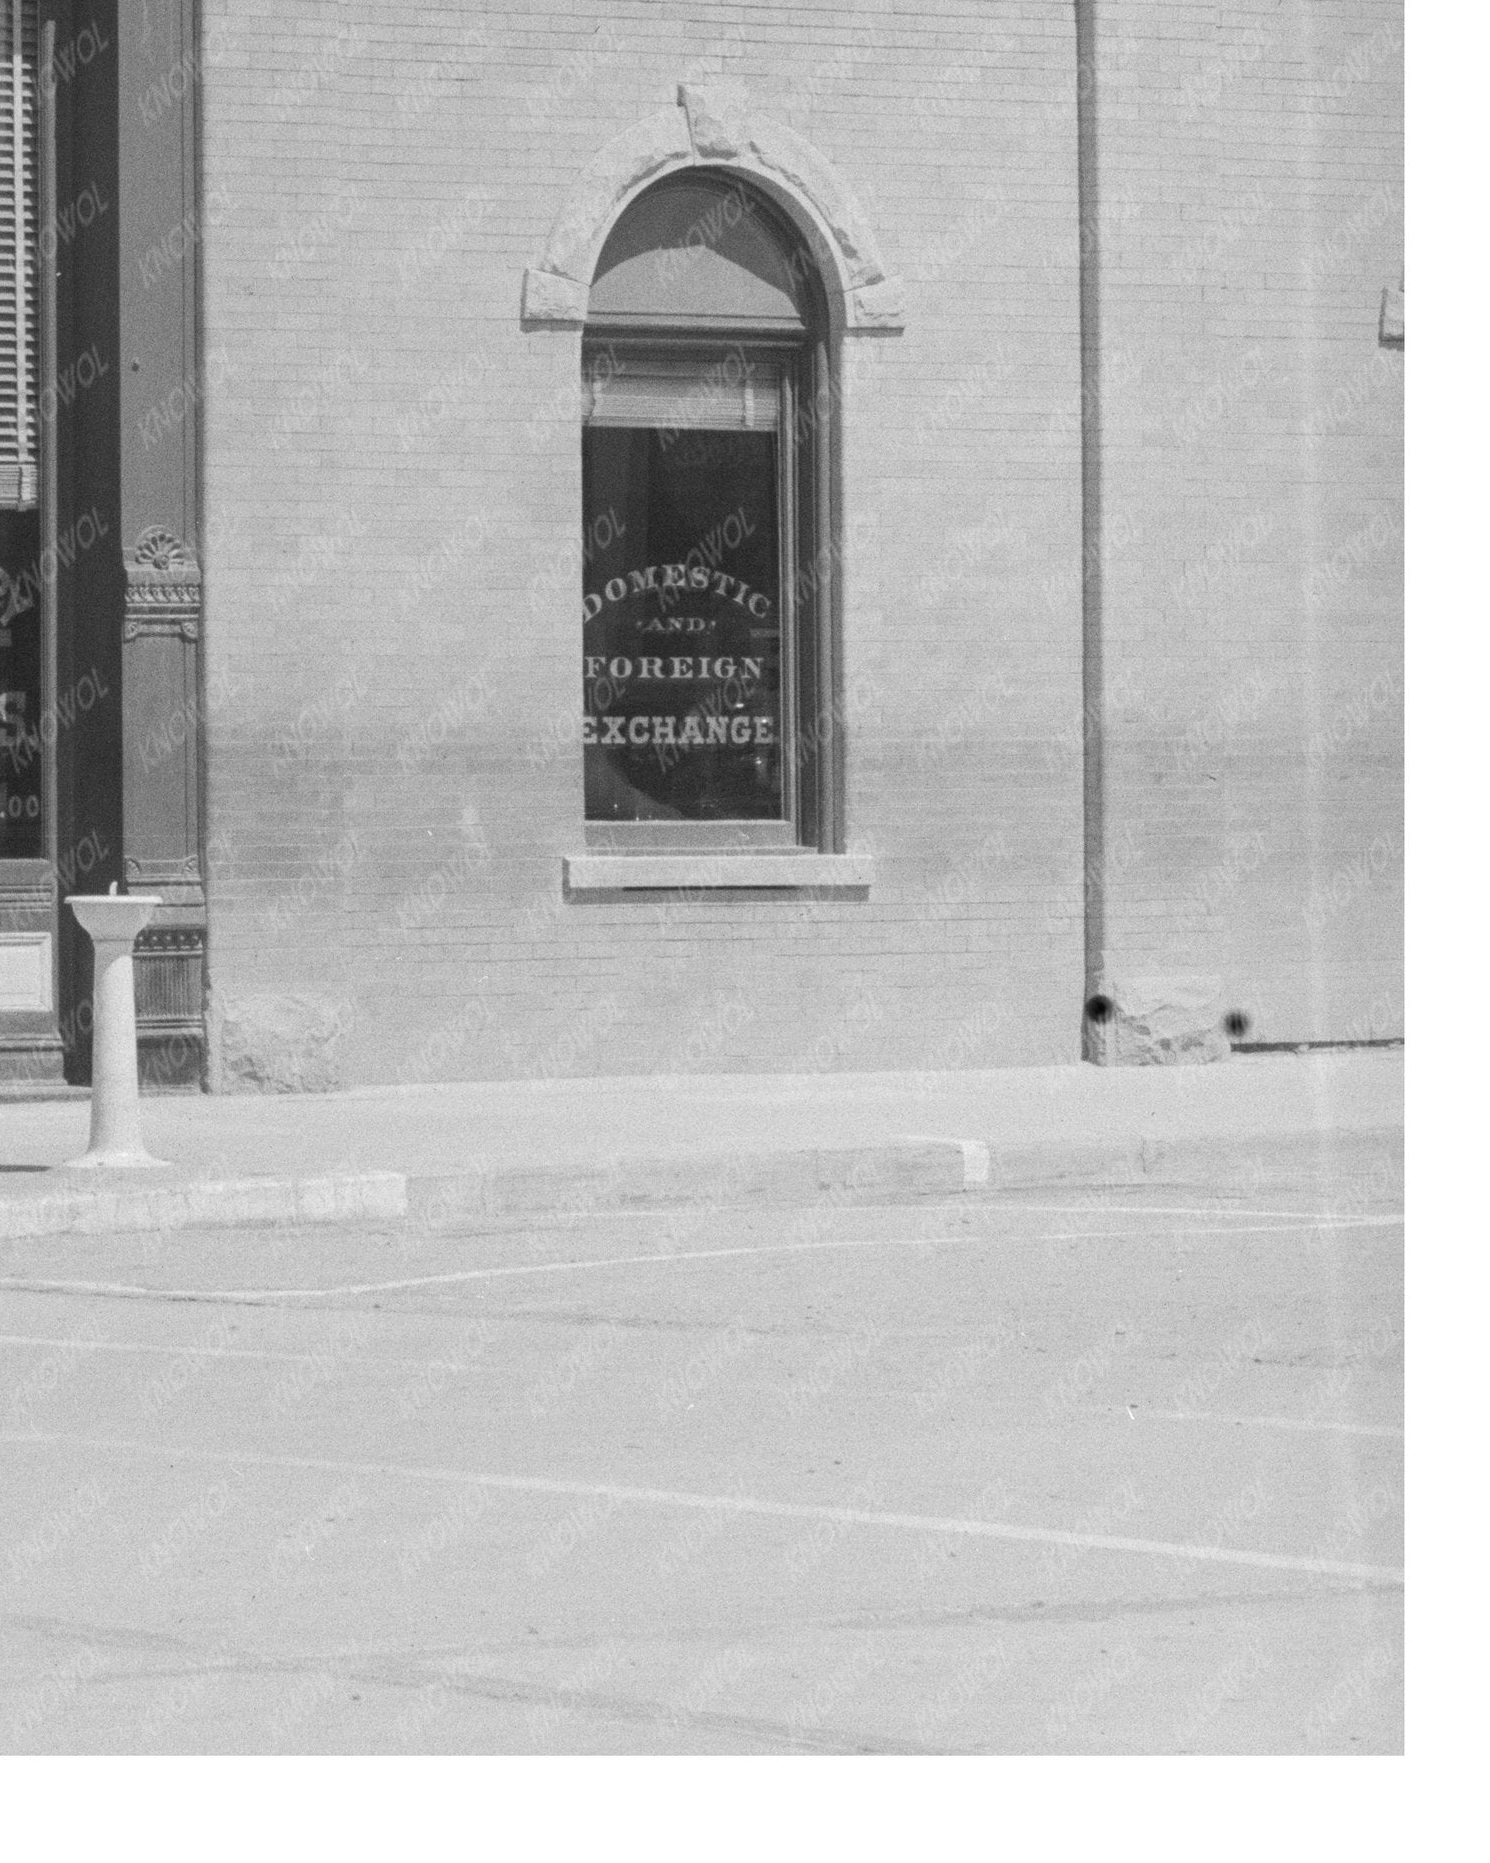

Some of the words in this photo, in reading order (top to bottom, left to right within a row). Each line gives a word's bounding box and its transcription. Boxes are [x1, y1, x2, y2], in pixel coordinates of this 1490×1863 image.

[583, 564, 770, 623] DOMESTIC
[644, 617, 706, 631] AND
[584, 656, 765, 679] FOREIGN
[583, 716, 774, 744] EXCHANGE
